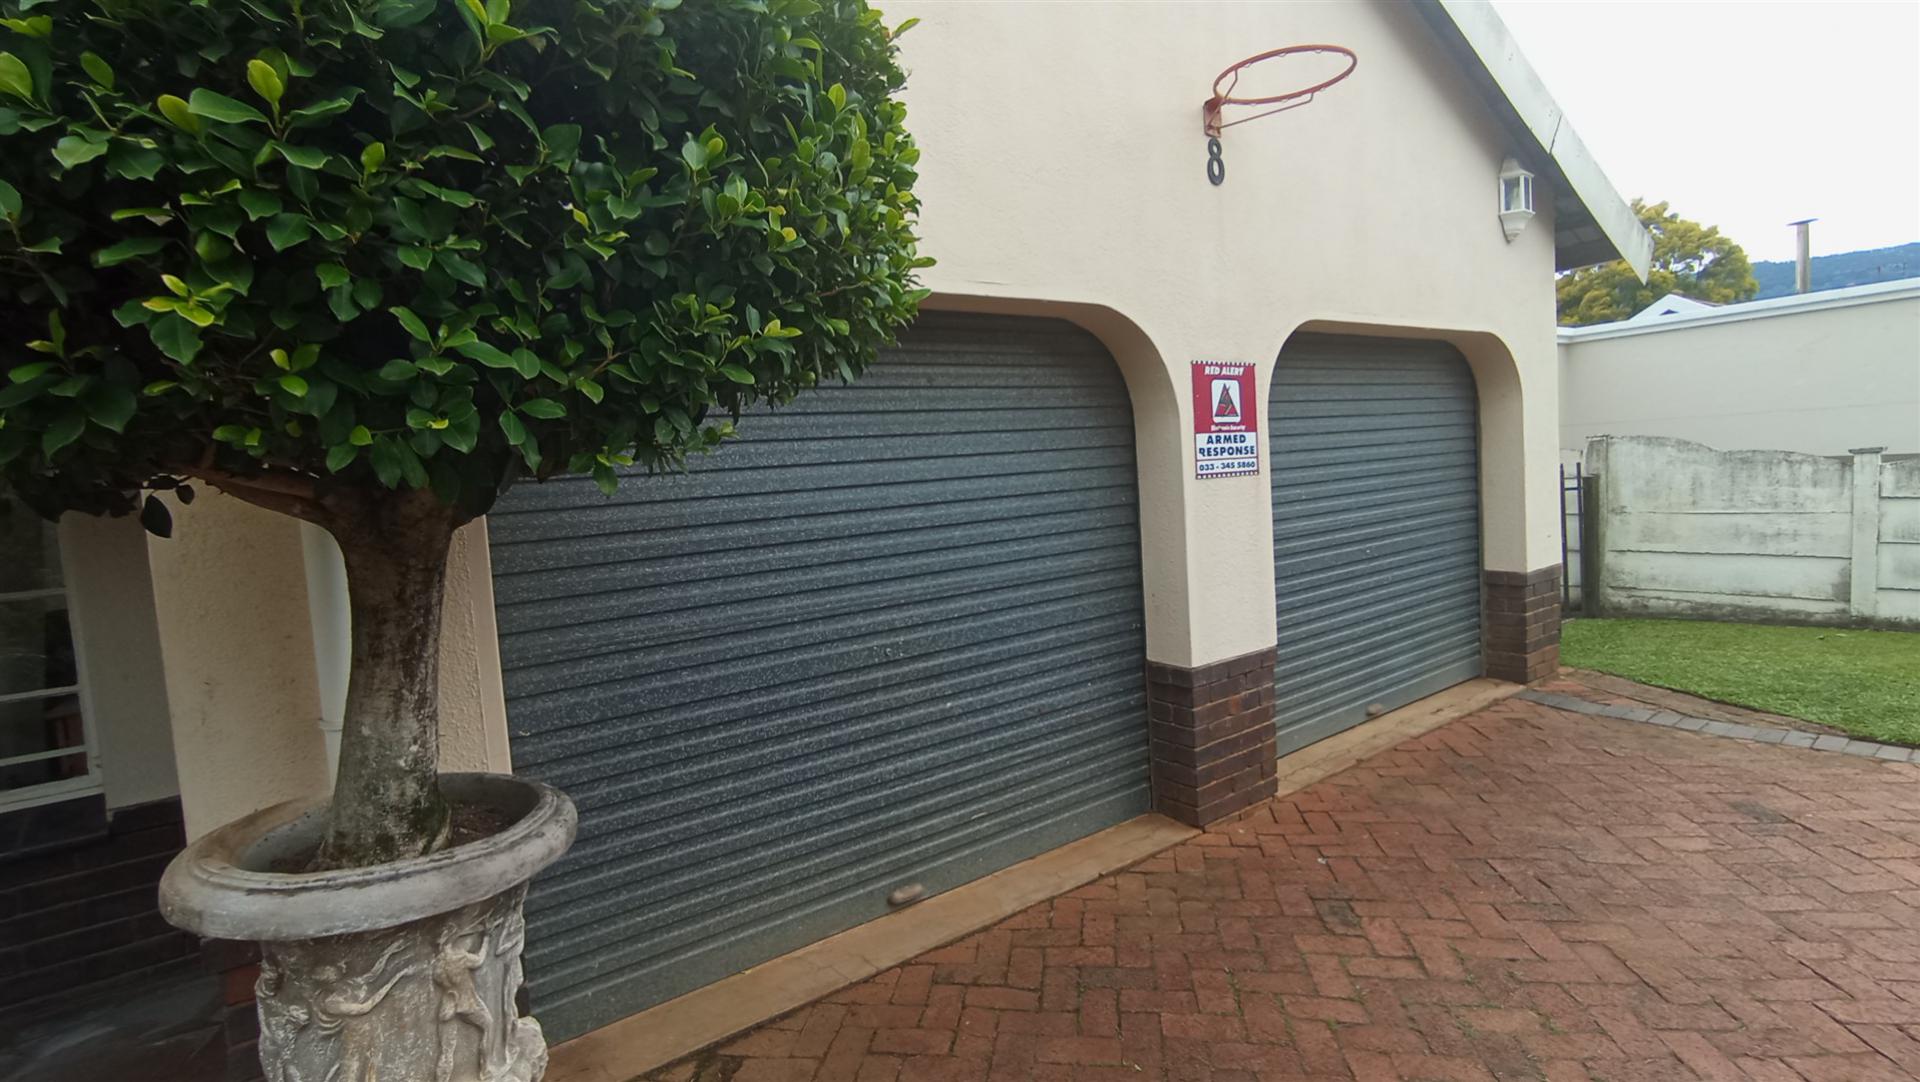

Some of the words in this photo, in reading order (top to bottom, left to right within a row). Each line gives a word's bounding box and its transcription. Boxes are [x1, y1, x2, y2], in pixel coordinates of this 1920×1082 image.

[1207, 137, 1225, 186] 8
[1206, 434, 1247, 445] ARMED
[1198, 446, 1255, 456] RESPONSE
[1199, 463, 1215, 471] 033
[1220, 462, 1236, 470] 345
[1236, 461, 1255, 469] 5860
